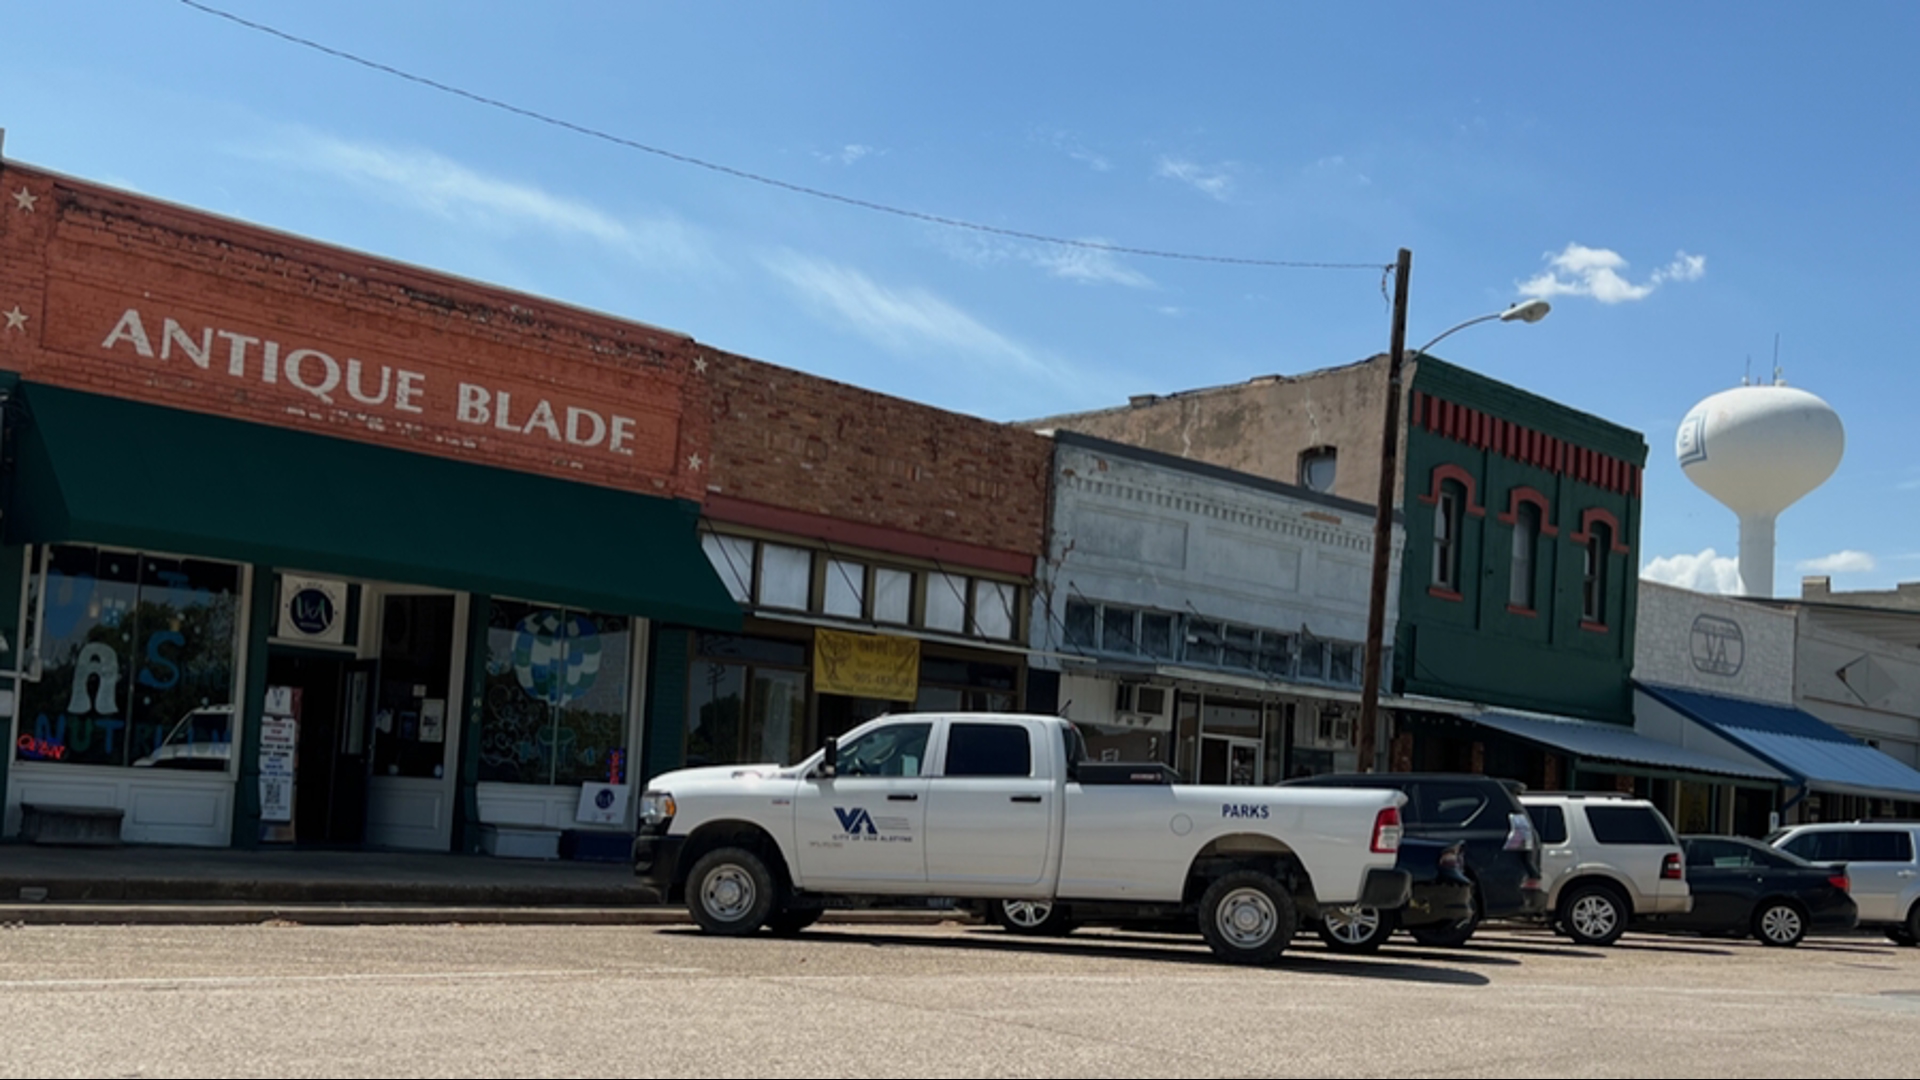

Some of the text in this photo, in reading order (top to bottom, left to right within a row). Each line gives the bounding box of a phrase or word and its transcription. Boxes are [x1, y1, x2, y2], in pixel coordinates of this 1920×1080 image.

[102, 309, 637, 456] ANTIQUE BLADE
[833, 807, 878, 834] VA
[1221, 804, 1270, 819] PARKS
